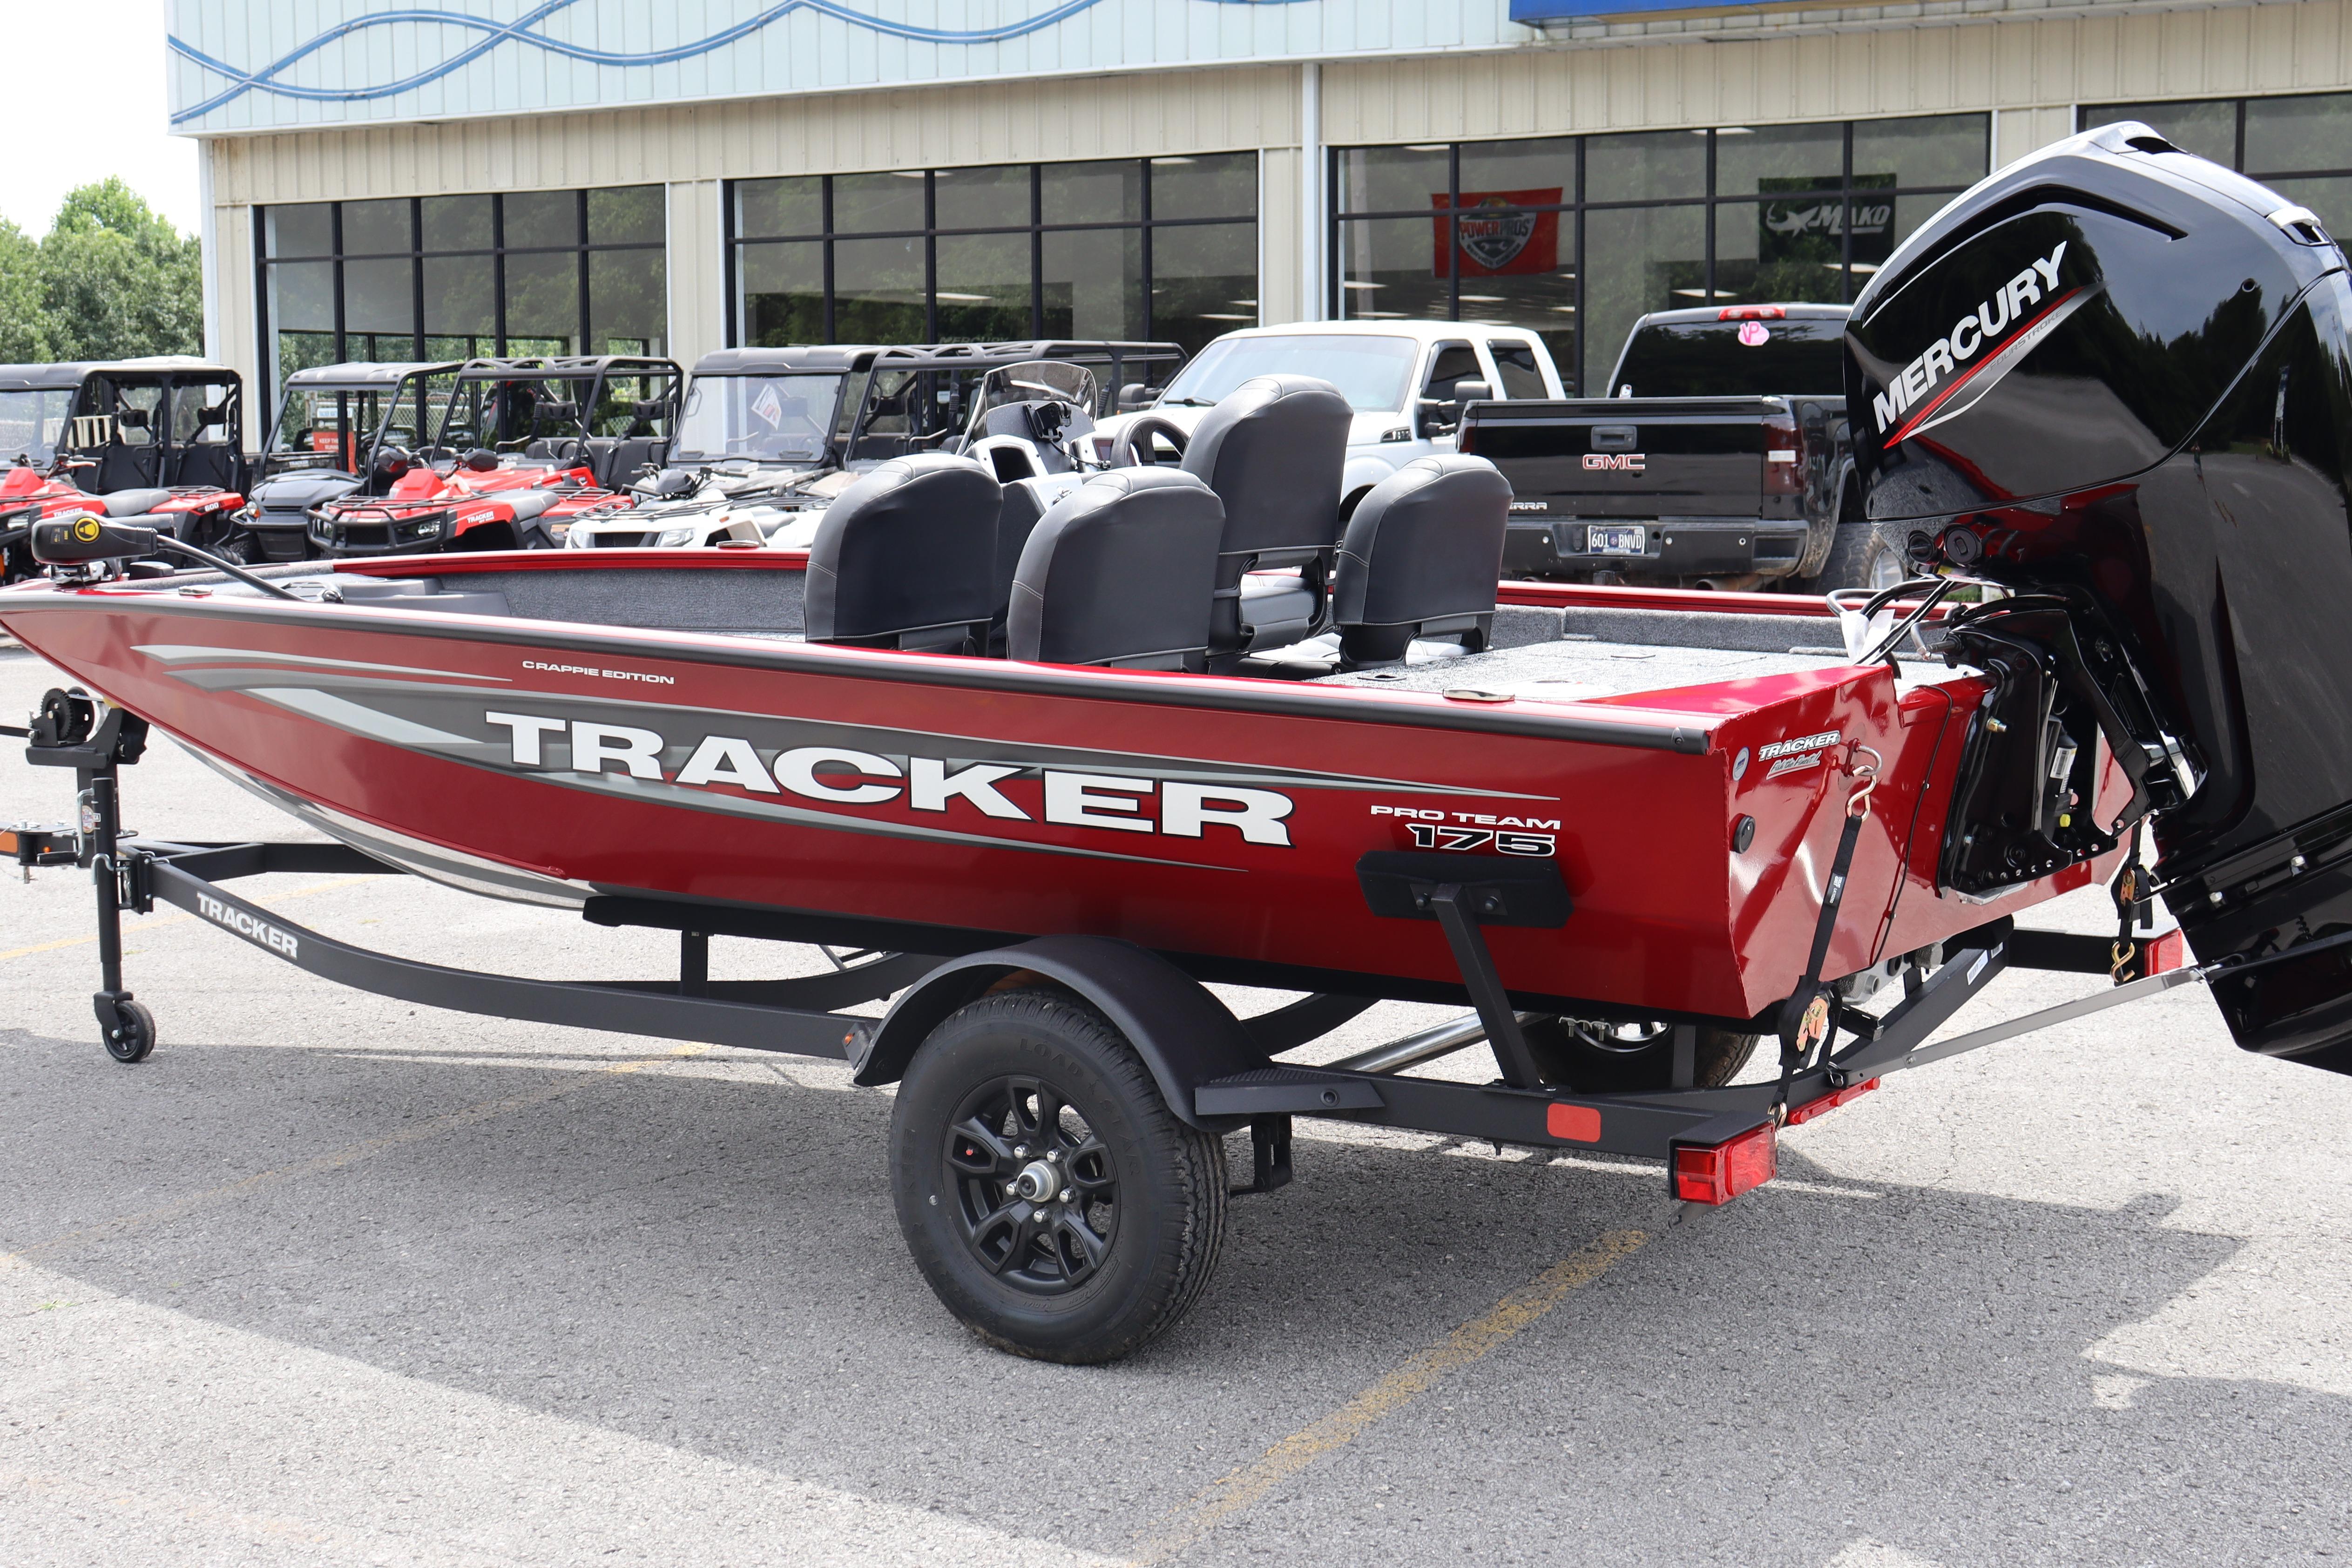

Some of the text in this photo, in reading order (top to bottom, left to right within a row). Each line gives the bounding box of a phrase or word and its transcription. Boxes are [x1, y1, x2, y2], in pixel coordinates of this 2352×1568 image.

[1873, 240, 2067, 434] MERCURY
[1987, 307, 2064, 372] FOURSTROKE
[1582, 453, 1645, 470] GMC
[205, 502, 219, 512] 600
[466, 511, 494, 524] TRACKER
[1591, 533, 1642, 549] 601 BNVD
[522, 660, 675, 685] CRAPPIE EDITION
[1760, 732, 1839, 759] TRACKER
[484, 710, 1296, 848] TRACKER
[1370, 804, 1561, 831] PRO TEAM
[1405, 823, 1556, 858] 175
[196, 892, 298, 960] TRACKER
[1019, 1038, 1084, 1078] LOAD
